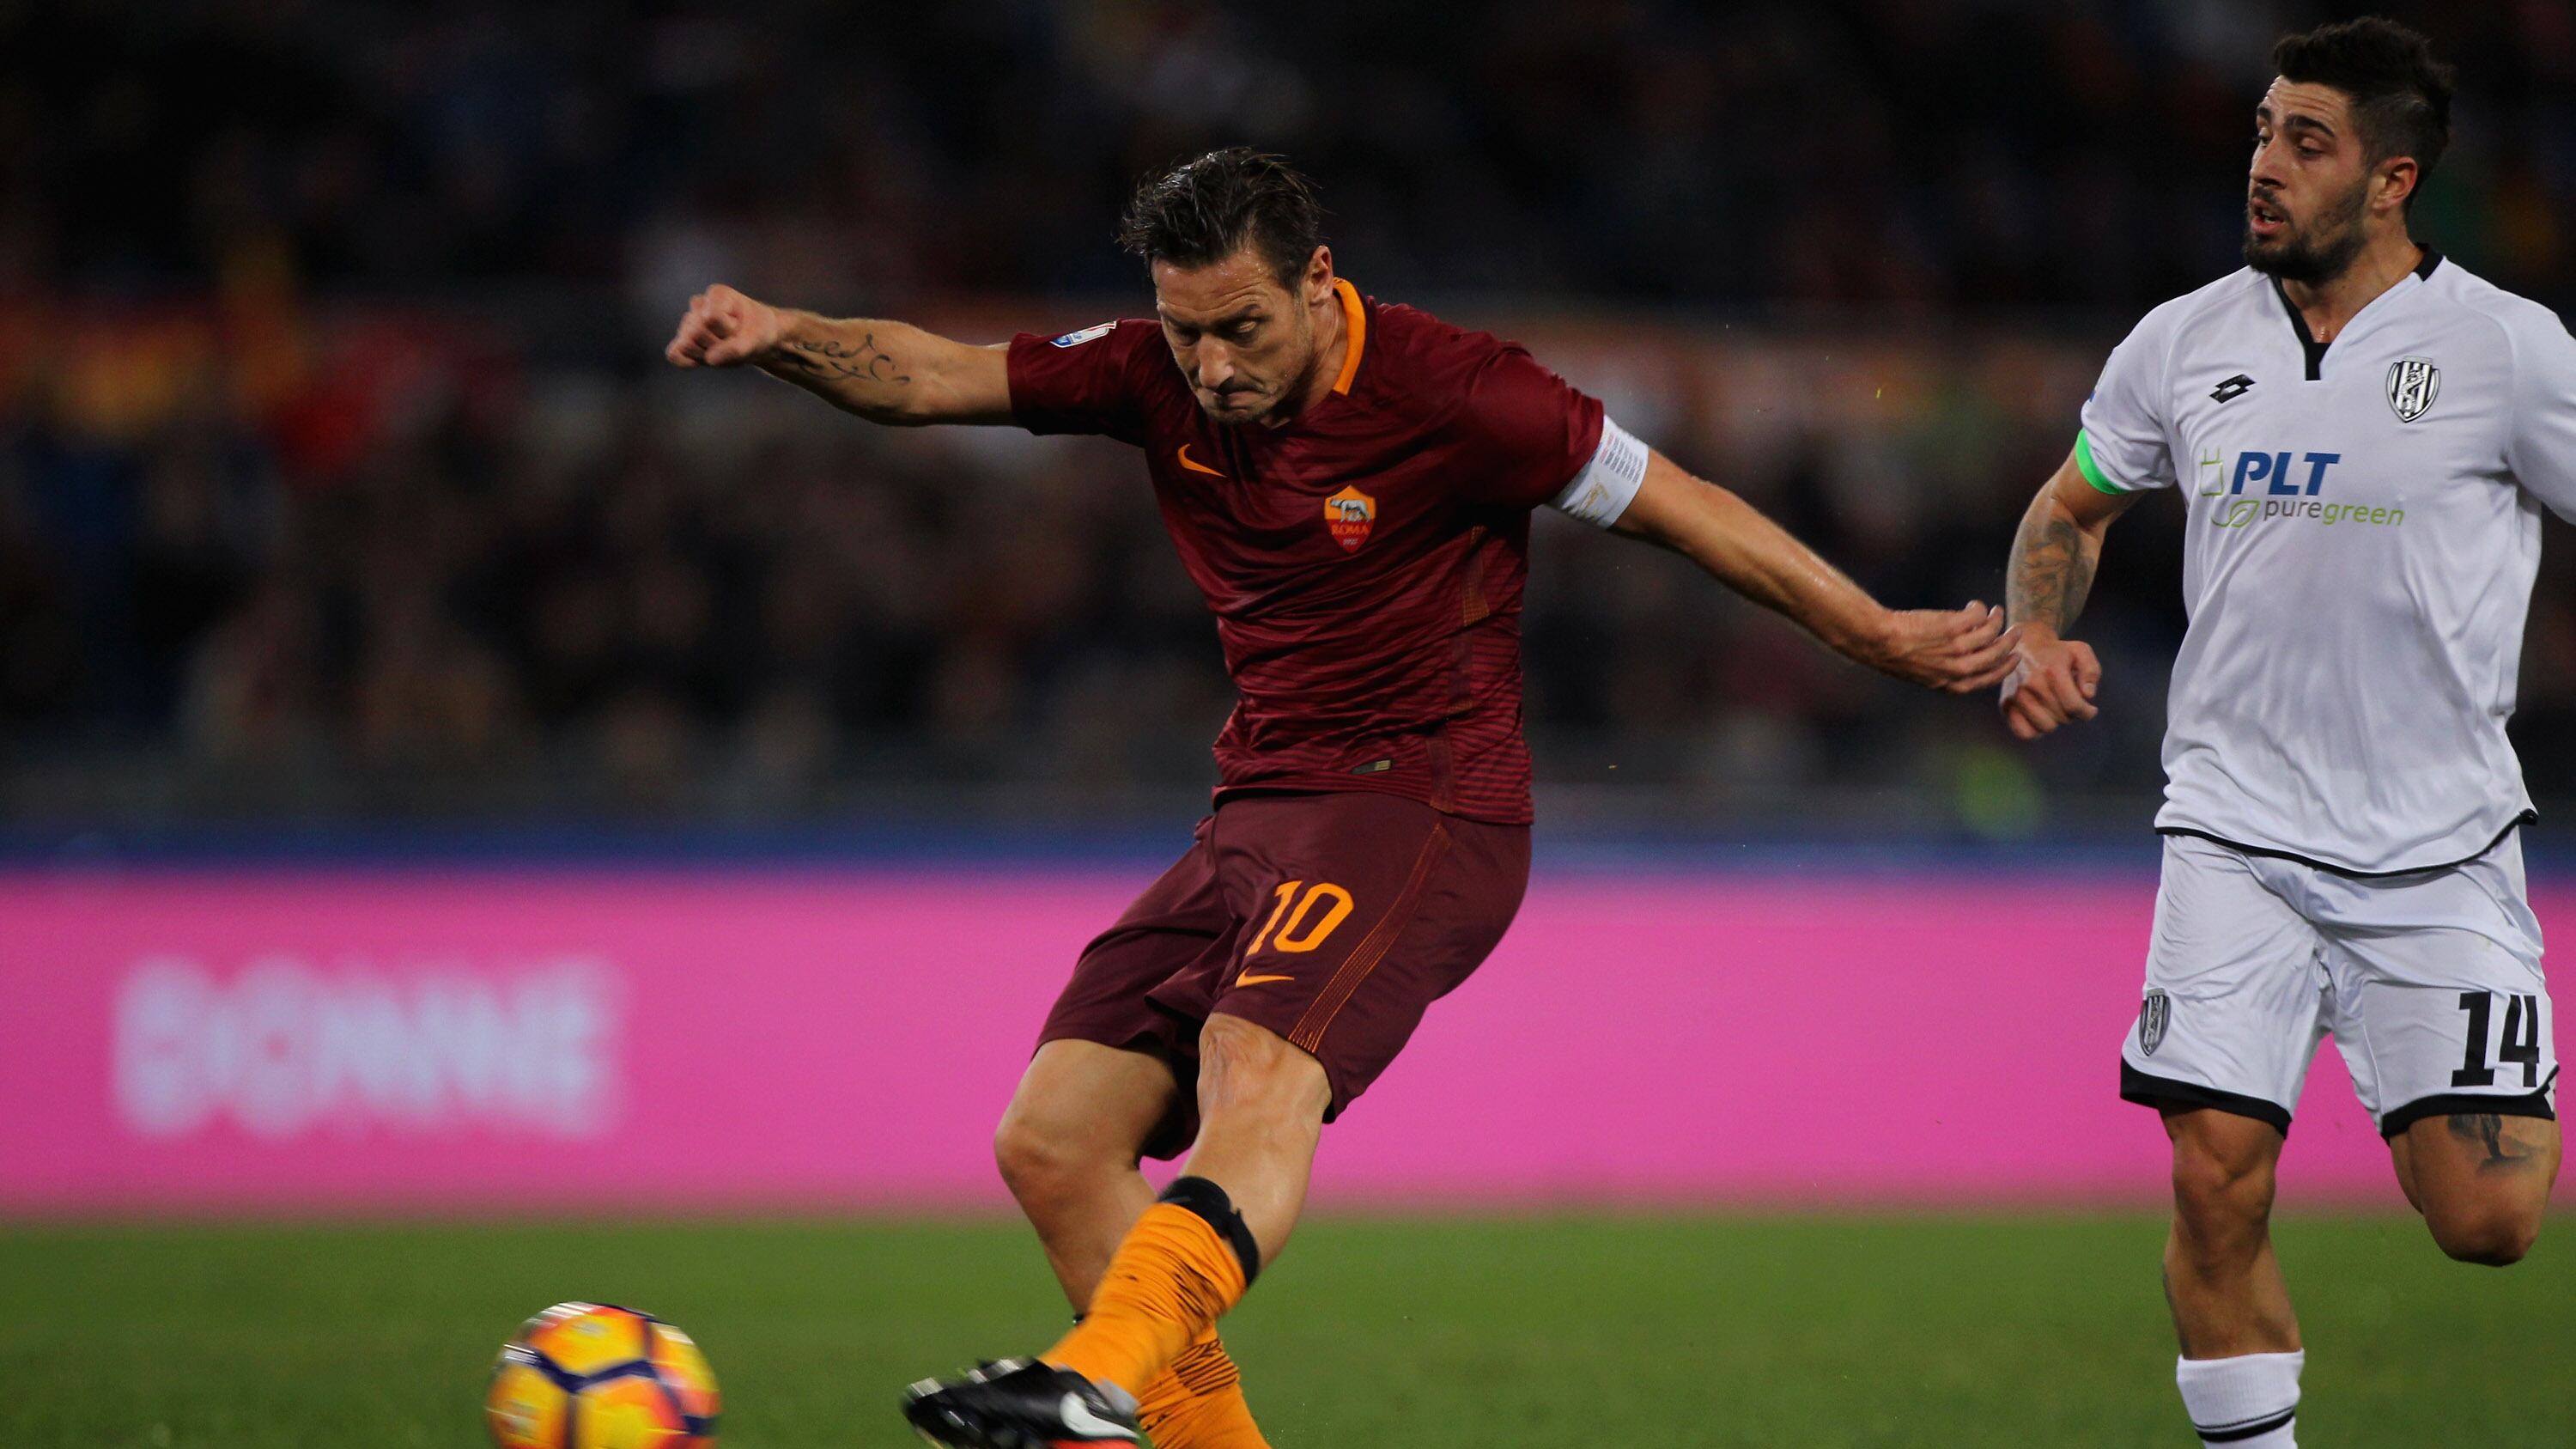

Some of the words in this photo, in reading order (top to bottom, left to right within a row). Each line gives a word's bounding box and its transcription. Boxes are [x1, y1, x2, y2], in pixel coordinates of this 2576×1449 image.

[2231, 452, 2341, 496] PLT
[1332, 524, 1370, 535] ROMA
[1246, 880, 1354, 957] 10
[2451, 991, 2539, 1087] 14
